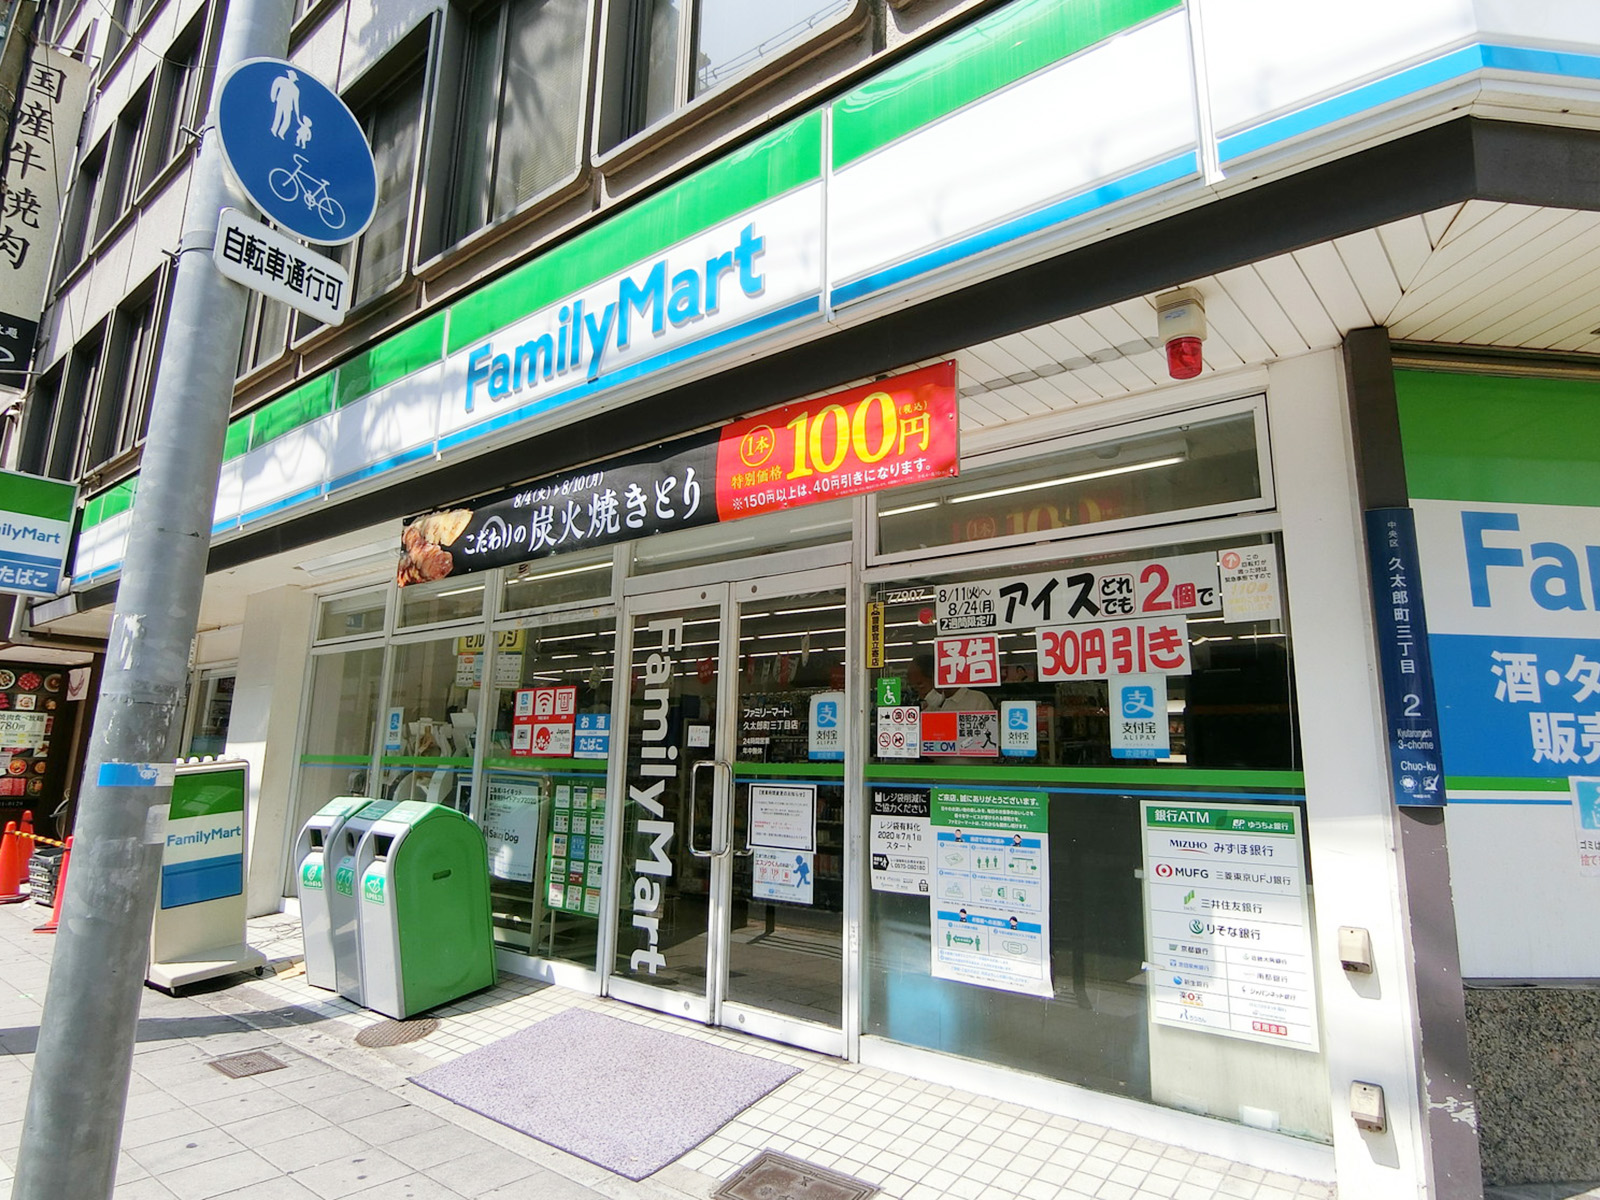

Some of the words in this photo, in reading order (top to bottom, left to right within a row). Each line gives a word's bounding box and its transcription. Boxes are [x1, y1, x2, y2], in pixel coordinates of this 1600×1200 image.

[0, 60, 67, 270] 国産牛焼肉
[224, 226, 344, 311] 自転車通行可
[465, 222, 766, 414] FamilyMart
[730, 465, 783, 490] 特別価格
[464, 522, 527, 556] こだわりの
[528, 466, 702, 553] 炭火焼きとり
[0, 522, 61, 544] ilyMart
[1387, 520, 1399, 548] 中央区
[1460, 510, 1600, 612] Fa
[0, 565, 49, 588] たばこ
[998, 573, 1101, 624] アイス
[1388, 556, 1415, 674] 久太郎町三丁目
[1041, 626, 1186, 676] 30円引き
[940, 639, 993, 684] 予告
[743, 707, 790, 718] ファミリーマート
[1402, 692, 1421, 717] 2
[742, 719, 799, 731] 久太郎町三丁目店
[959, 714, 997, 723] 防犯カメラで
[816, 729, 838, 741] 支付宝
[959, 729, 982, 738] 監視中
[1122, 721, 1157, 734] 支付宝
[579, 738, 604, 751] たばこ
[1007, 732, 1029, 741] 支付宝
[1398, 738, 1434, 750] 3-chome
[923, 741, 956, 752] SECOM
[1400, 760, 1437, 771] Chuo-ku
[629, 616, 684, 975] FamilyMart
[882, 793, 927, 804] レジ袋削減に
[874, 803, 928, 814] ご協力ください
[1154, 808, 1210, 824] 銀行ATM
[880, 820, 922, 832] レジ袋有料化
[1247, 821, 1289, 831] ゆうちょ銀行
[166, 825, 242, 848] FamilyMart
[504, 832, 519, 844] Dog
[877, 831, 922, 842] 2020年7月1日
[886, 841, 913, 851] スタート
[1169, 839, 1208, 850] MIZUHO
[1213, 841, 1274, 858] みずほ銀行
[1174, 867, 1209, 879] MUFG
[1215, 870, 1291, 886] 三菱東京UFJ銀行
[1200, 898, 1263, 914] 三井住友銀行
[1205, 924, 1261, 940] りそな銀行
[1180, 945, 1209, 956] 京都銀行
